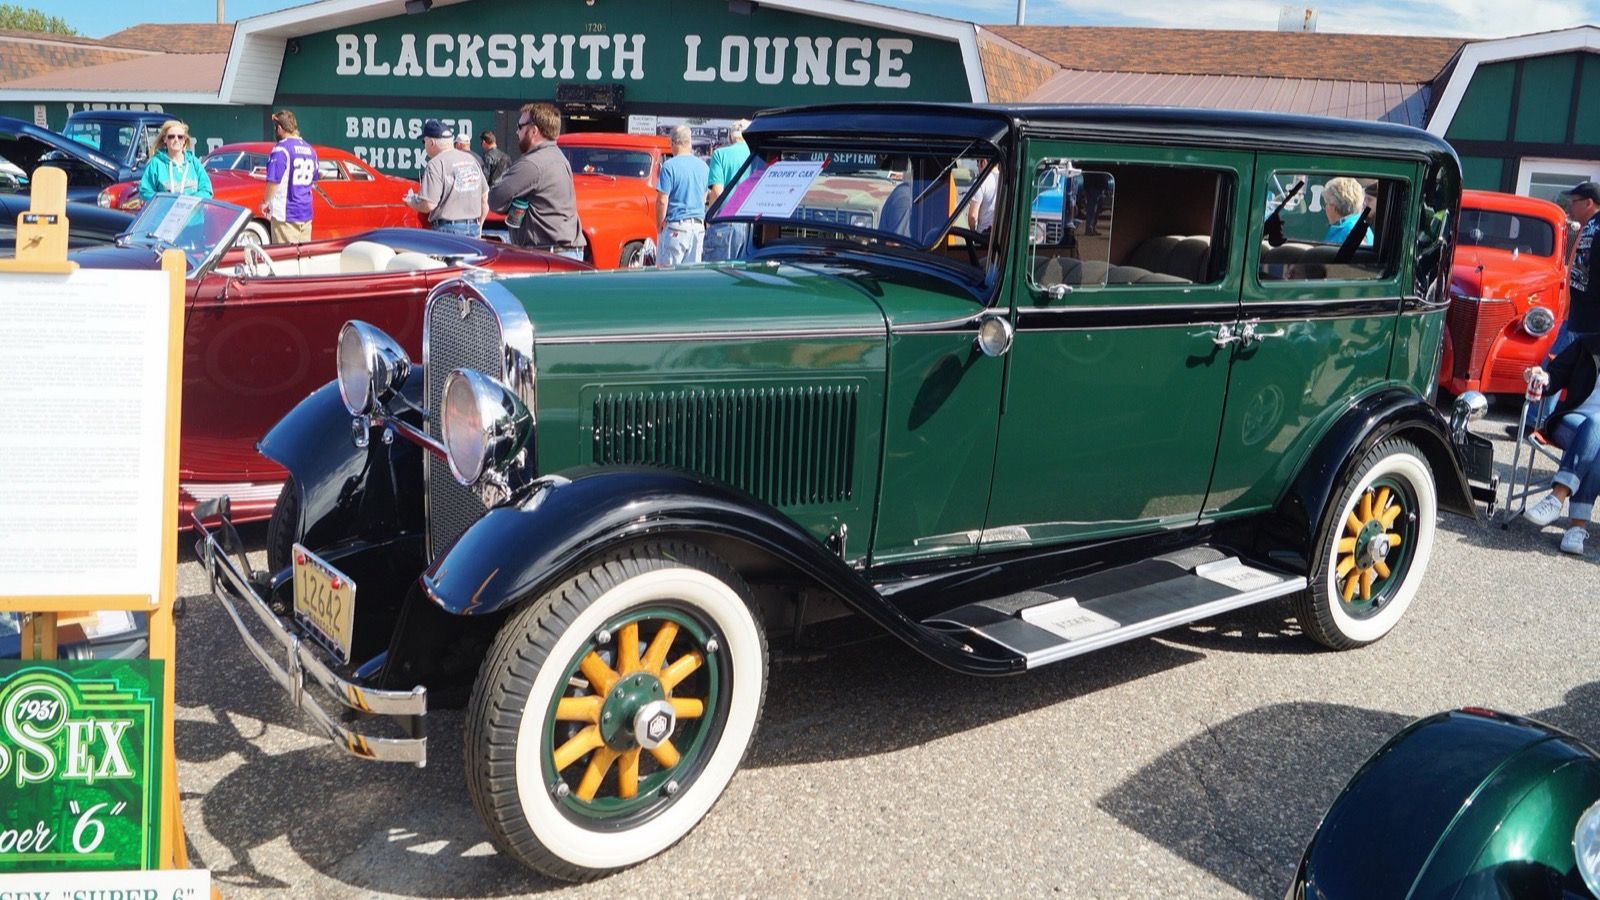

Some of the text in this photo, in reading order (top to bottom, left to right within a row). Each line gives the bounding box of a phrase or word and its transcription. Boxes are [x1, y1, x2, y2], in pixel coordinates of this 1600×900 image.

[335, 33, 913, 88] BLACKSMITH LOUNGE
[346, 116, 473, 140] BROASED
[354, 146, 428, 169] CHICK
[293, 157, 315, 186] 28
[769, 170, 814, 178] TROPHY CAR
[303, 569, 342, 632] 12642
[17, 699, 60, 721] 1931
